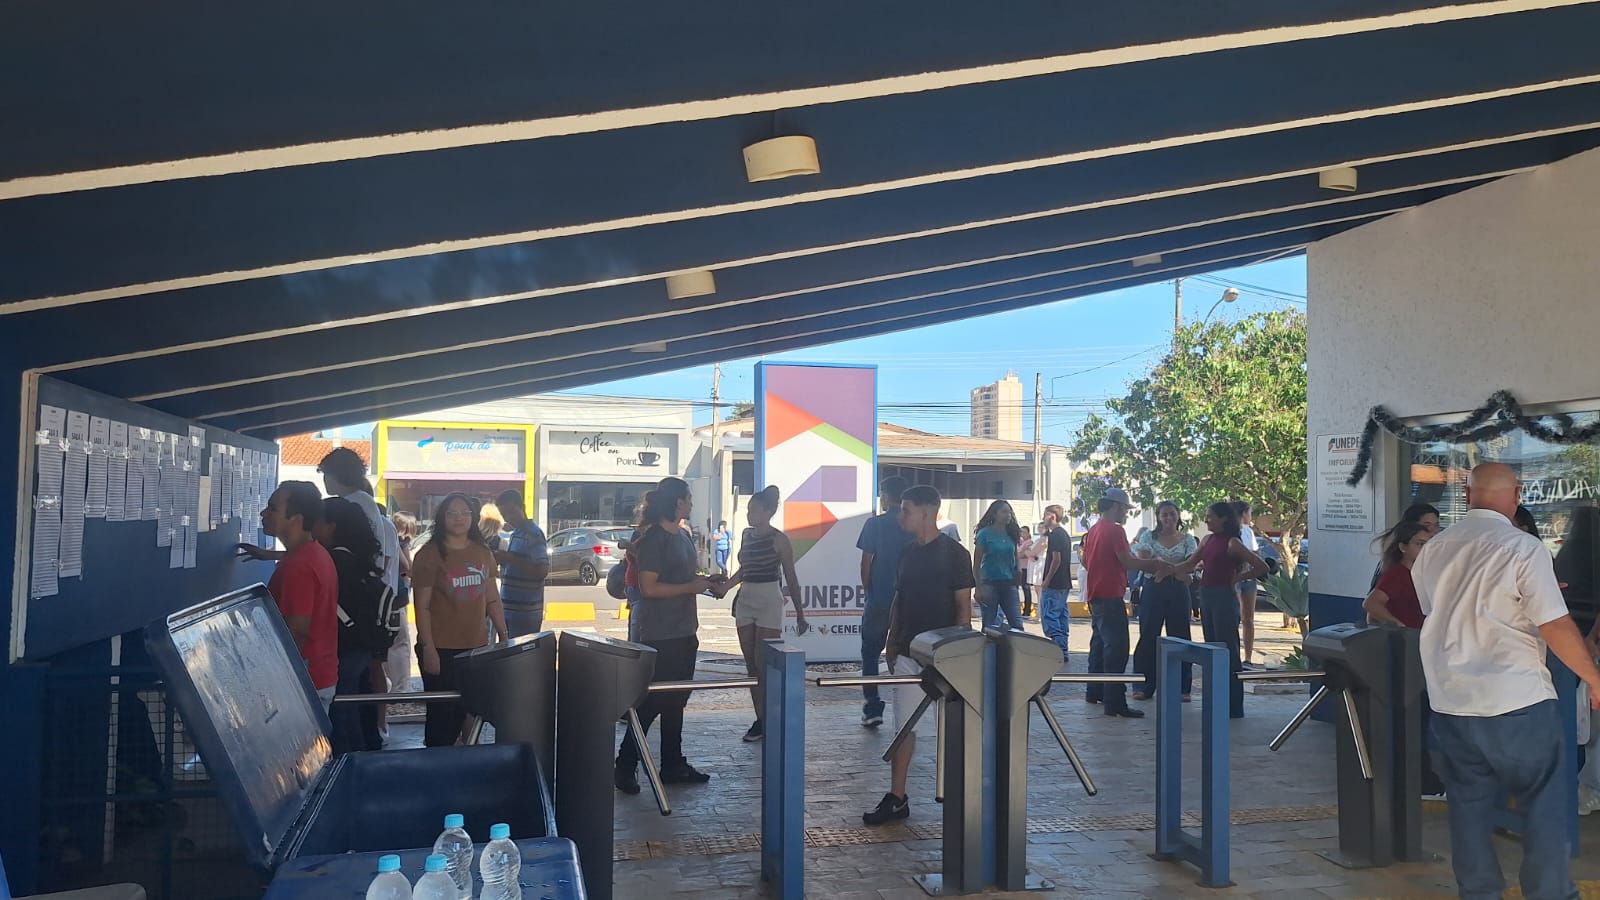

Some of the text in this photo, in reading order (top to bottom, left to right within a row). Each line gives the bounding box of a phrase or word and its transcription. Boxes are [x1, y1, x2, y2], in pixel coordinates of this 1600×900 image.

[580, 433, 610, 454] Coffee
[616, 457, 638, 465] Point
[452, 574, 481, 588] PUMA
